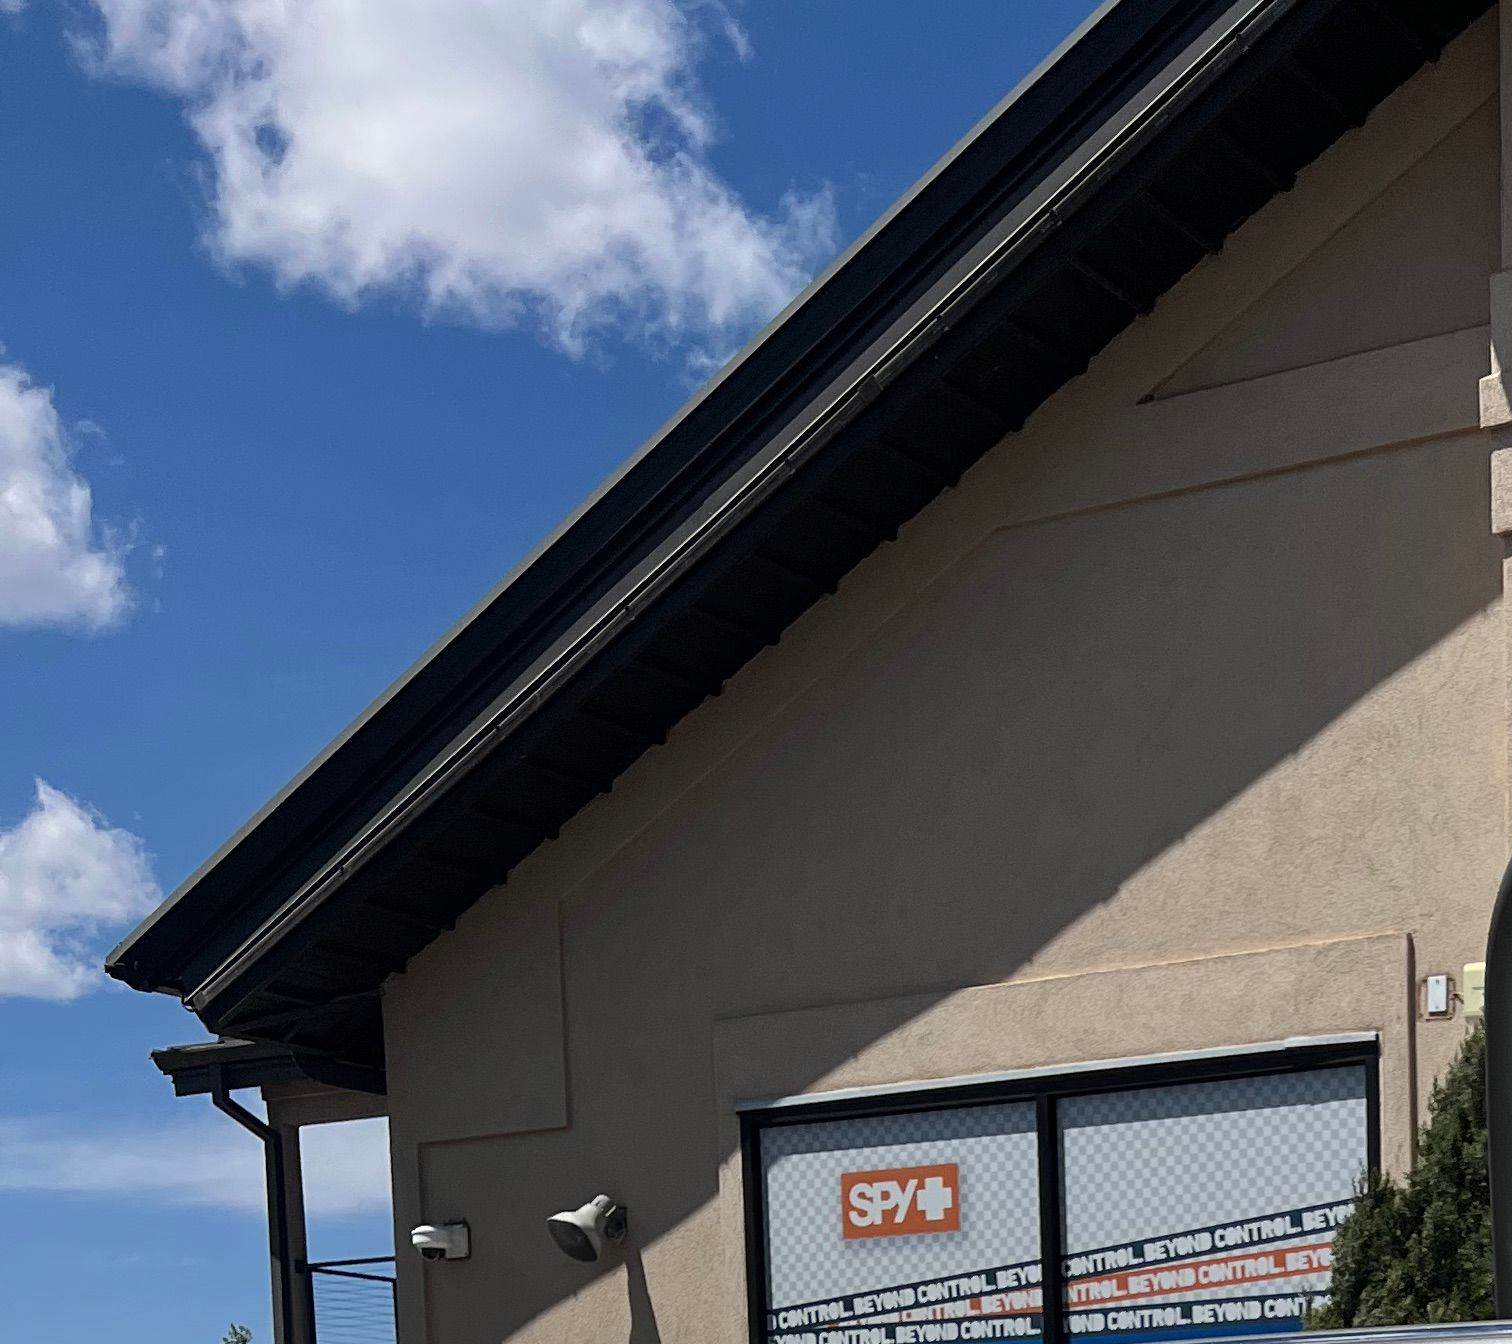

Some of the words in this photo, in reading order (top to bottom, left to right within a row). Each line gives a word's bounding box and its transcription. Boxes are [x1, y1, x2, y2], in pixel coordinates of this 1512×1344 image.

[853, 1288, 916, 1316] BEYOND
[1143, 1231, 1213, 1262] BEYOND
[1127, 1266, 1197, 1295] BEYOND
[895, 1323, 959, 1344] BEYOND
[1191, 1299, 1262, 1324] BEYOND
